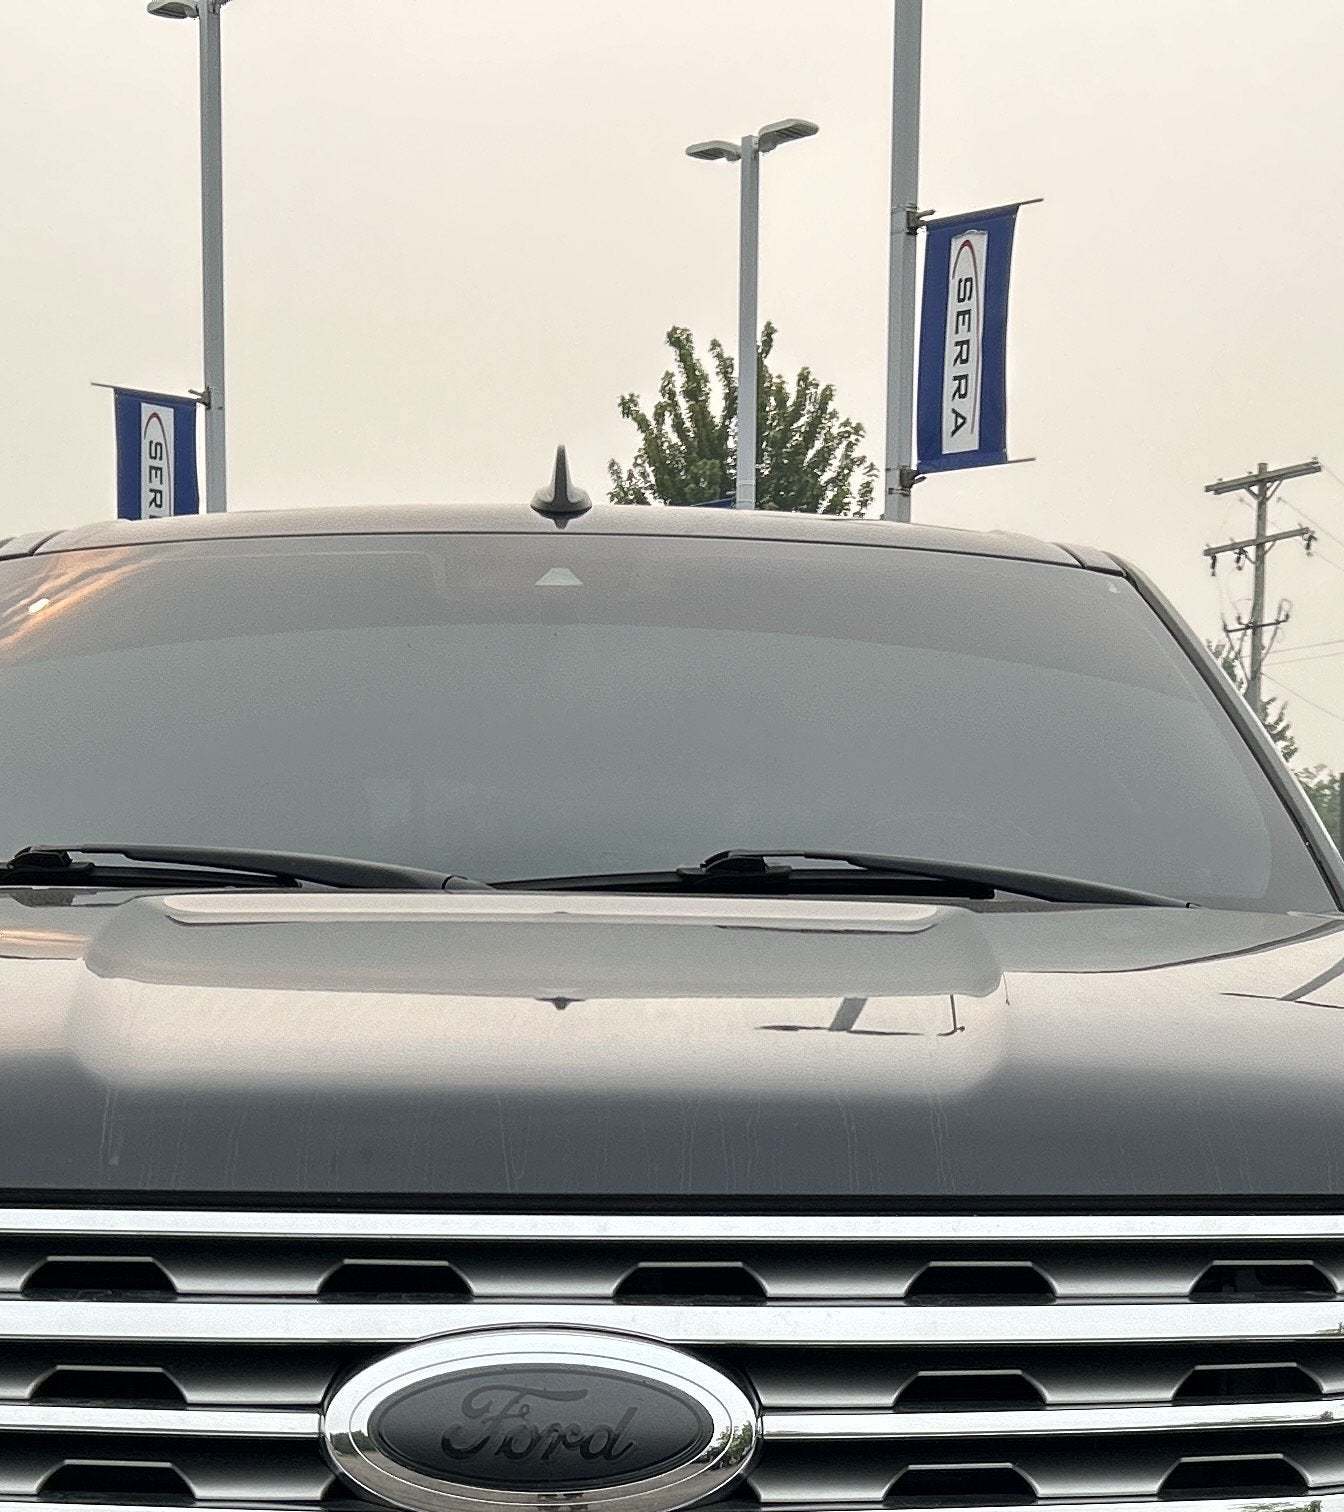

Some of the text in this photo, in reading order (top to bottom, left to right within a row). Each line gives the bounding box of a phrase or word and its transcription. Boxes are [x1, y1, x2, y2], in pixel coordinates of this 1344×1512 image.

[950, 276, 973, 438] SERRA
[148, 440, 163, 519] SER
[441, 1384, 638, 1462] Ford
